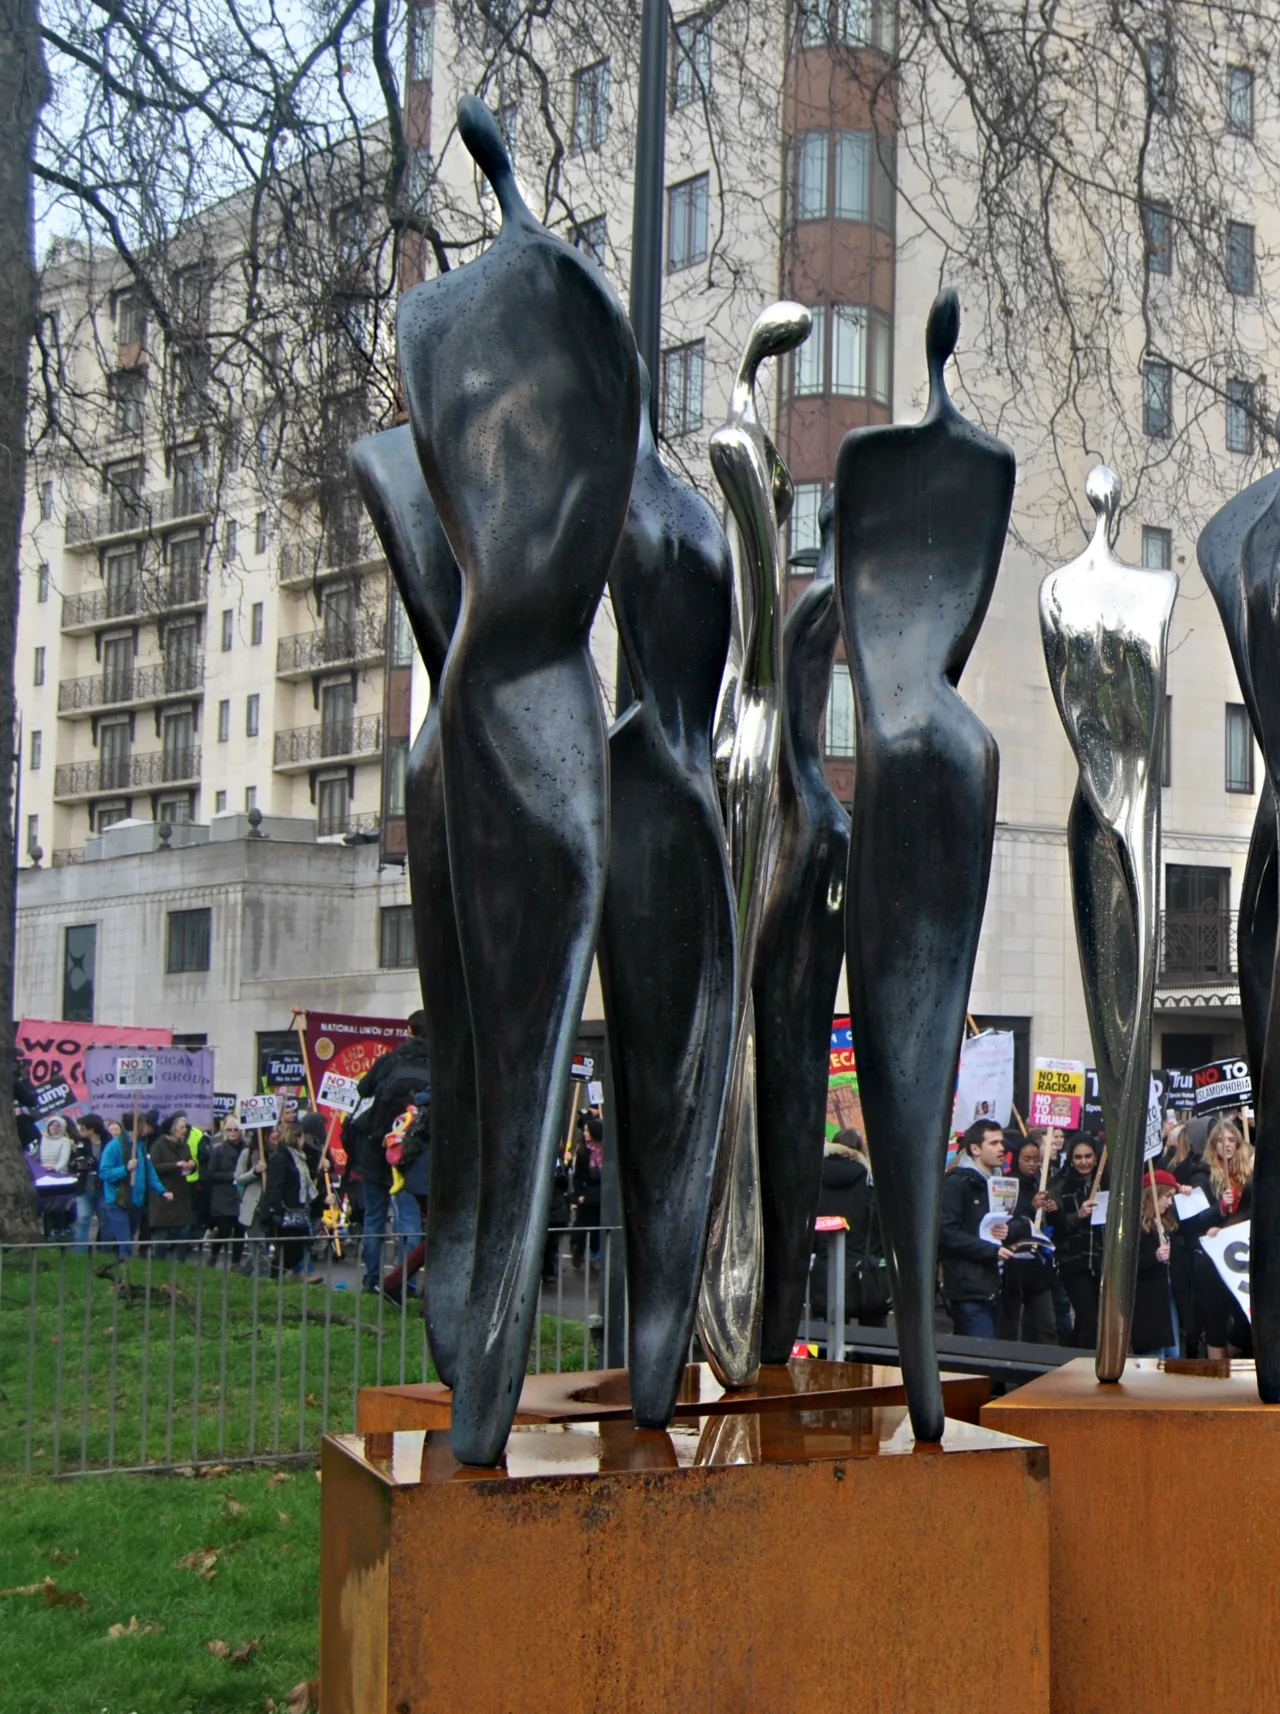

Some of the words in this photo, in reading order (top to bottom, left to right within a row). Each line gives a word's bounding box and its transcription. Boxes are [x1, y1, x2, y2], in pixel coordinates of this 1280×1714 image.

[321, 1023, 357, 1034] NATIONAL
[121, 1060, 139, 1069] NO
[142, 1059, 154, 1068] TO
[162, 1071, 211, 1086] GROUP
[1038, 1071, 1053, 1081] NO
[1056, 1073, 1070, 1083] TO
[1195, 1067, 1219, 1088] NO
[1222, 1061, 1248, 1080] TO
[327, 1075, 345, 1087] NO
[1037, 1081, 1076, 1093] RACISM
[38, 1083, 70, 1104] ump
[1196, 1079, 1251, 1101] ISLAMOPHOBIA
[240, 1099, 258, 1108] NO
[261, 1097, 275, 1106] TO
[1036, 1094, 1051, 1104] NO
[1035, 1104, 1050, 1114] TO
[1034, 1113, 1071, 1126] TRUMP
